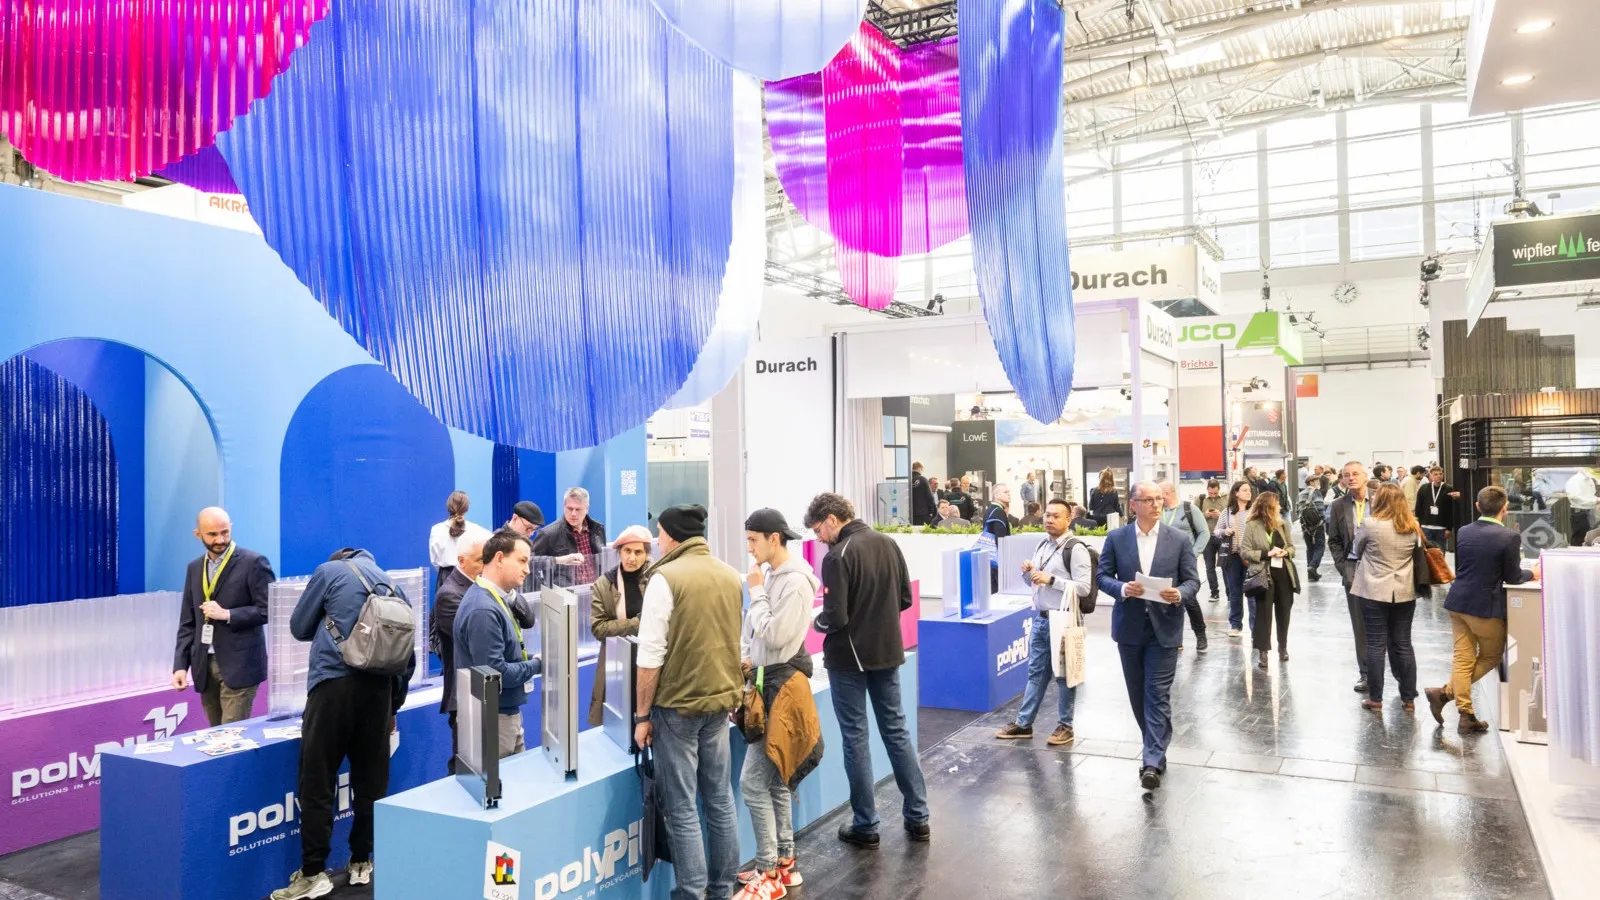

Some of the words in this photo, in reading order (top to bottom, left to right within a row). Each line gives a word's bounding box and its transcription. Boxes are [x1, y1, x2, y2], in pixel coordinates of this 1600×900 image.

[1512, 243, 1557, 261] wipfler
[1147, 315, 1172, 348] Durach
[756, 357, 817, 374] Durach
[1180, 360, 1214, 369] Brichta
[11, 786, 69, 805] SOLUTIONS
[73, 783, 84, 791] IN
[229, 832, 286, 856] SOLUTIONS
[290, 827, 300, 836] IN
[534, 817, 644, 900] polyPi
[587, 888, 596, 897] IN
